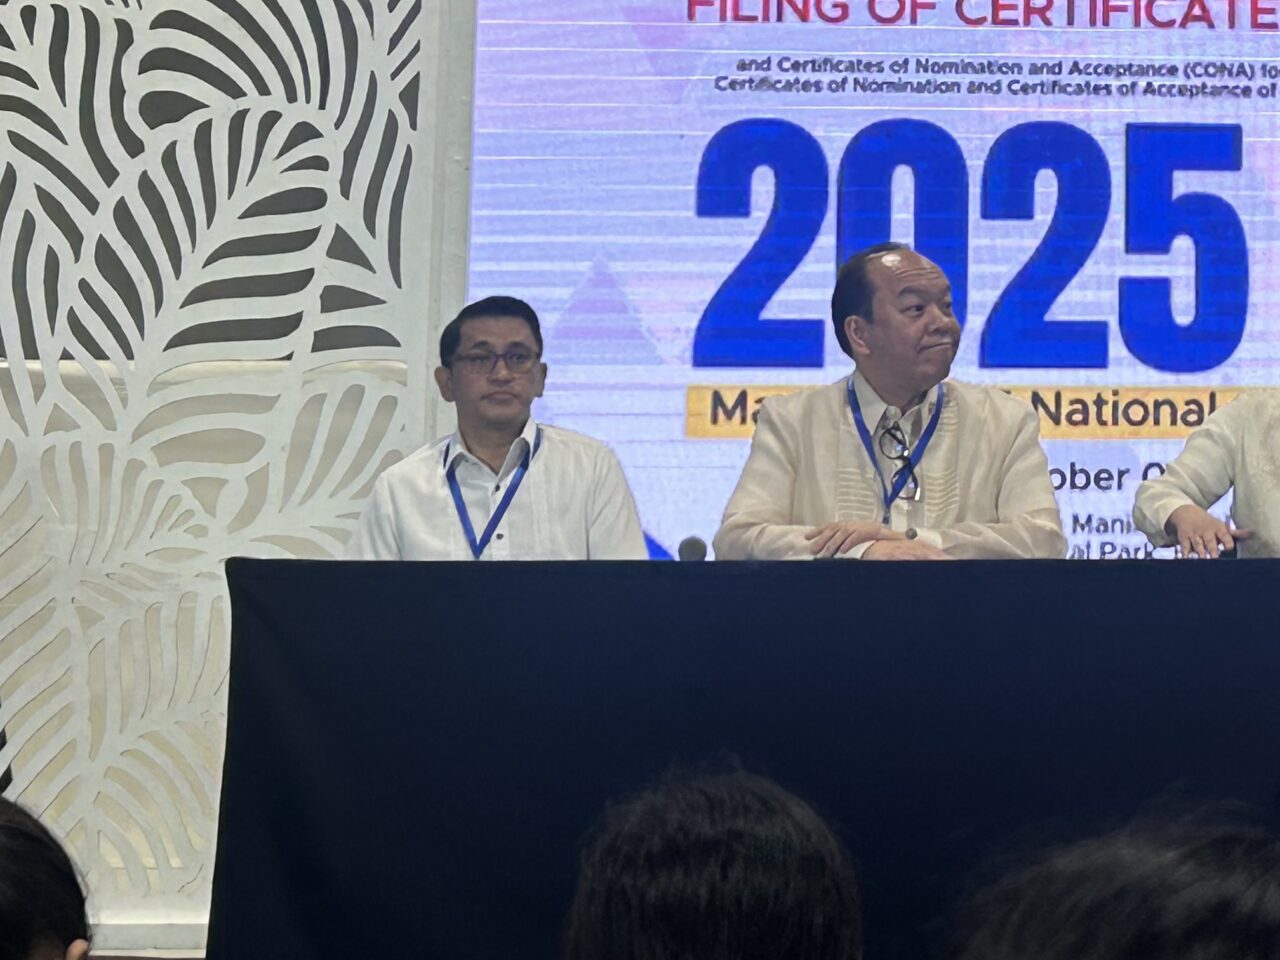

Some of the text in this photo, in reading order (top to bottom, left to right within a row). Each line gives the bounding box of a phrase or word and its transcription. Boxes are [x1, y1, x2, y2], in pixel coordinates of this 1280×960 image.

[736, 56, 772, 73] and
[777, 56, 884, 74] Certificates
[889, 58, 909, 74] of
[915, 58, 1023, 75] Nomination
[1029, 60, 1063, 75] and
[1068, 60, 1179, 78] Acceptance
[1183, 62, 1255, 80] (CONA)
[714, 75, 822, 92] Certificates
[827, 76, 848, 92] of
[853, 76, 961, 94] Nomination
[967, 79, 1001, 95] and
[1007, 79, 1112, 96] Certificates
[1118, 80, 1137, 97] of
[1143, 81, 1252, 99] Acceptance
[1257, 82, 1277, 98] of
[692, 117, 1247, 374] 2025
[711, 389, 764, 426] M
[1031, 388, 1216, 429] National
